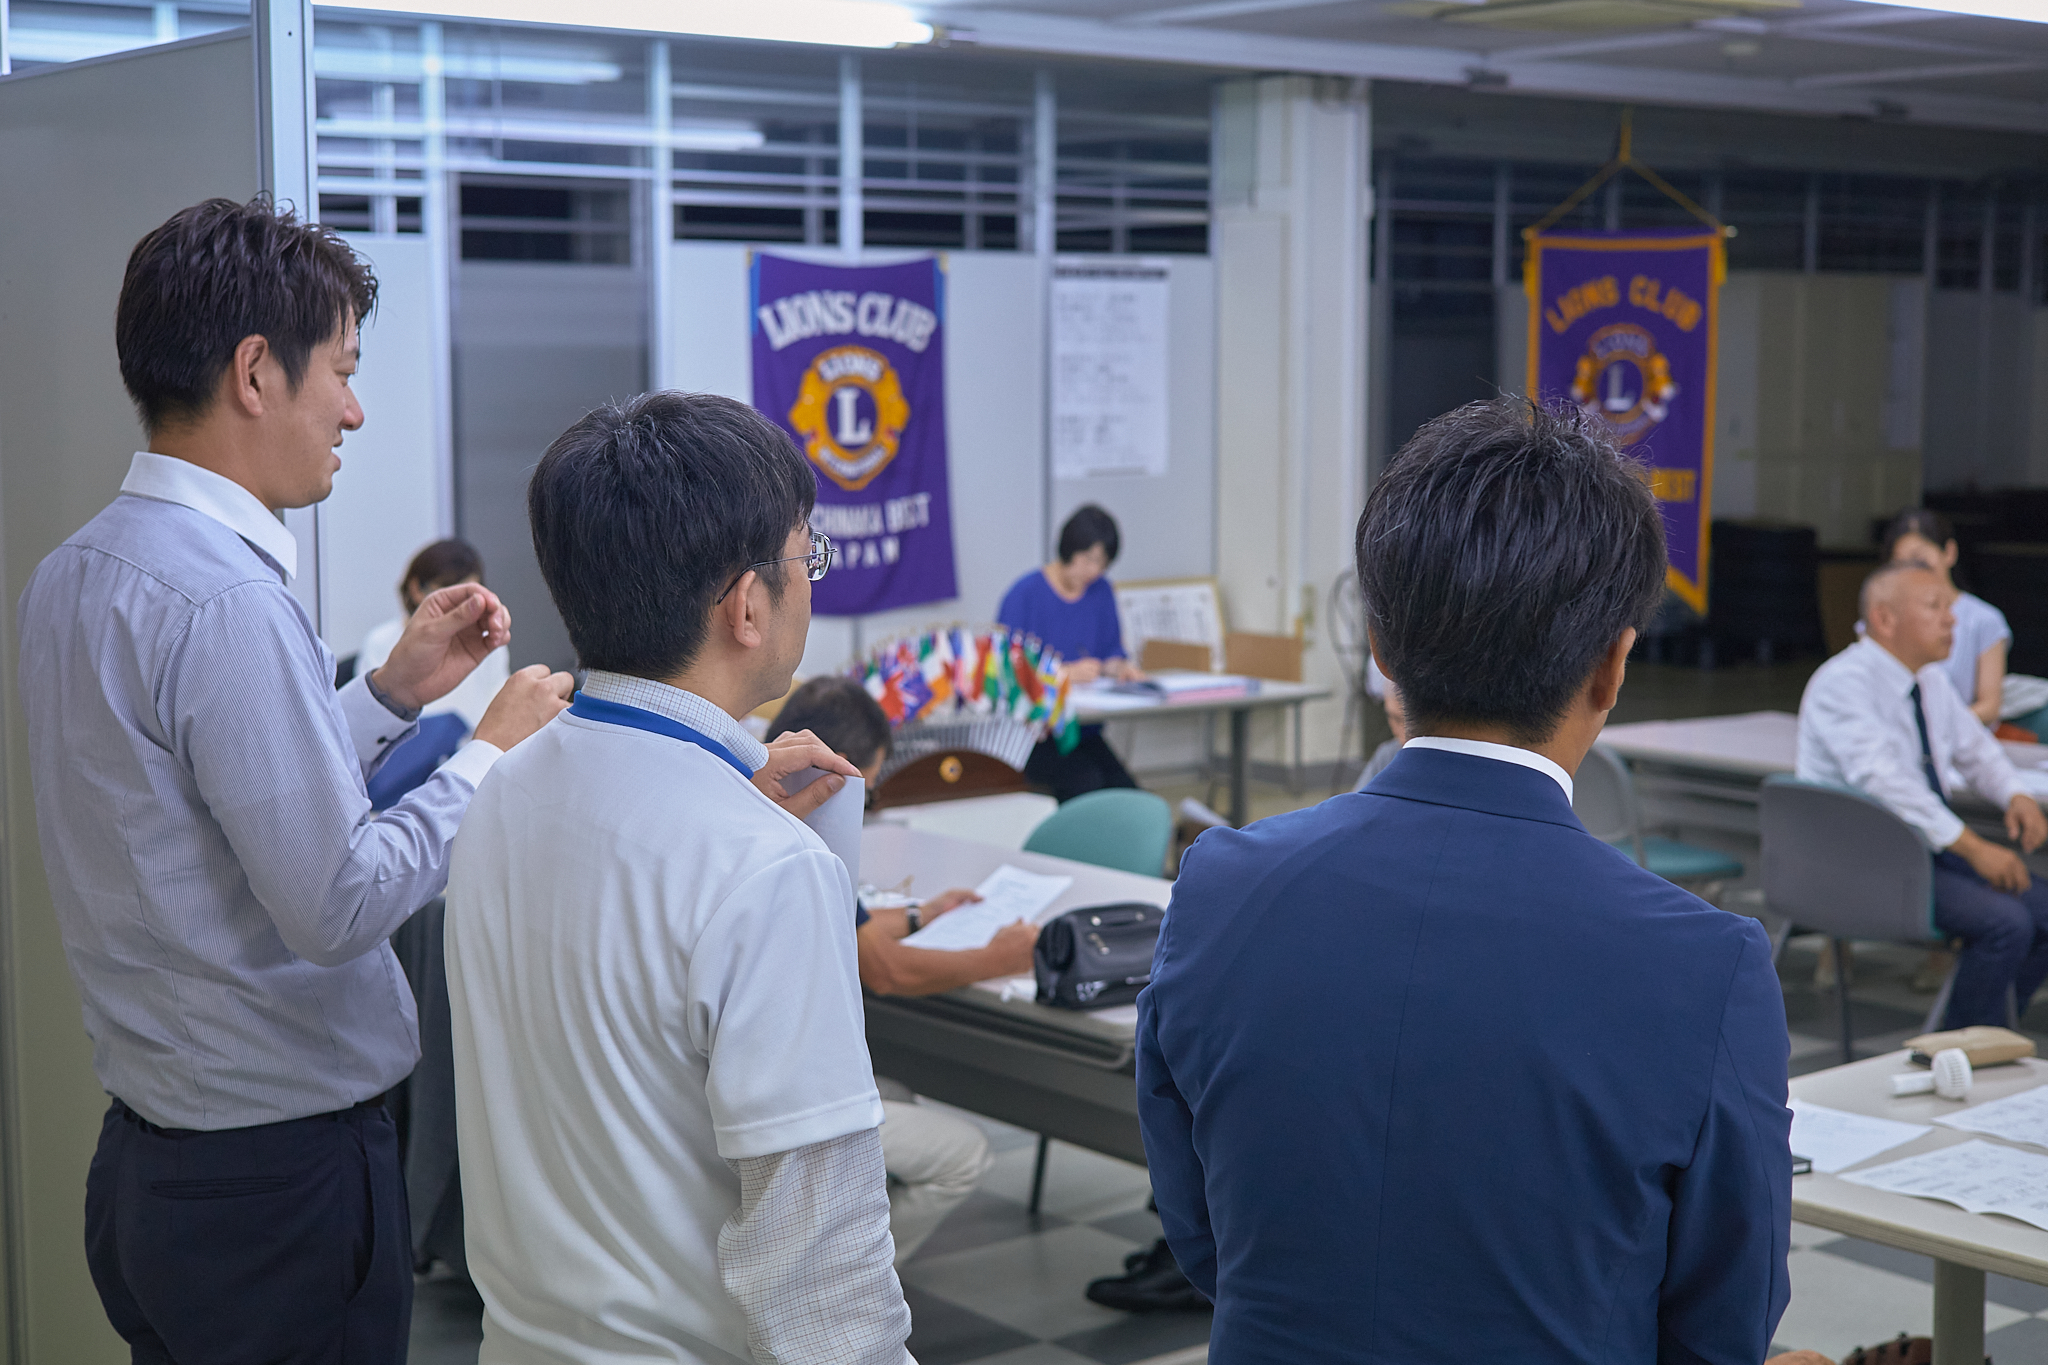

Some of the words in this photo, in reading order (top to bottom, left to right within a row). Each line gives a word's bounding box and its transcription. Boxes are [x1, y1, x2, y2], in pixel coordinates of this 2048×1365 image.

[760, 291, 856, 349] LIONS
[859, 293, 936, 351] CLUB
[1548, 278, 1617, 332] LIONS
[1630, 277, 1700, 330] CLUB
[1607, 363, 1633, 411] L
[838, 388, 870, 444] L
[829, 537, 898, 568] APAN
